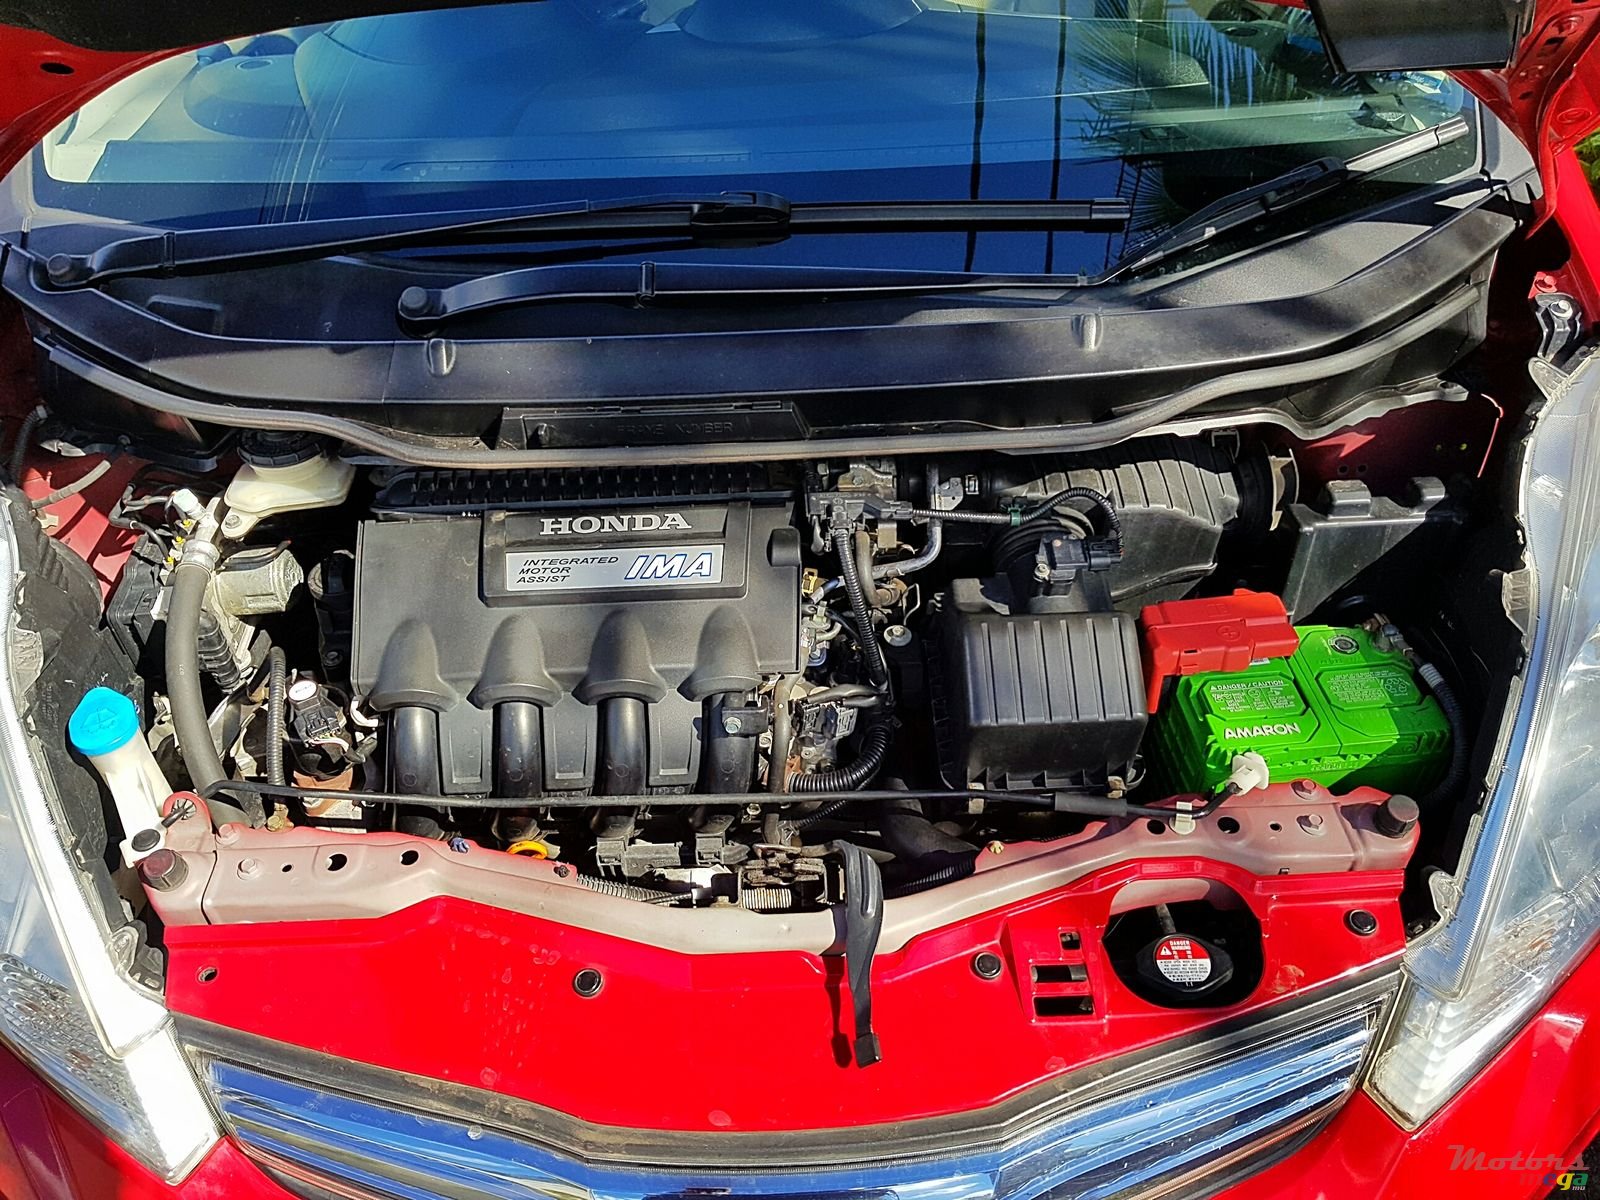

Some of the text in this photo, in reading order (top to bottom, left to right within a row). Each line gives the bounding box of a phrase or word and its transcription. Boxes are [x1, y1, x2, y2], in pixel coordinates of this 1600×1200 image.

[617, 421, 734, 435] FRAME NUMBER
[539, 513, 692, 536] HONDA
[523, 556, 619, 566] INTEGRATED
[624, 552, 713, 580] IMA
[519, 566, 571, 575] MOTOR
[516, 575, 570, 584] ASSIST
[1217, 683, 1246, 691] DANGER
[1252, 679, 1284, 688] CAUTION
[1224, 723, 1301, 740] AMARON
